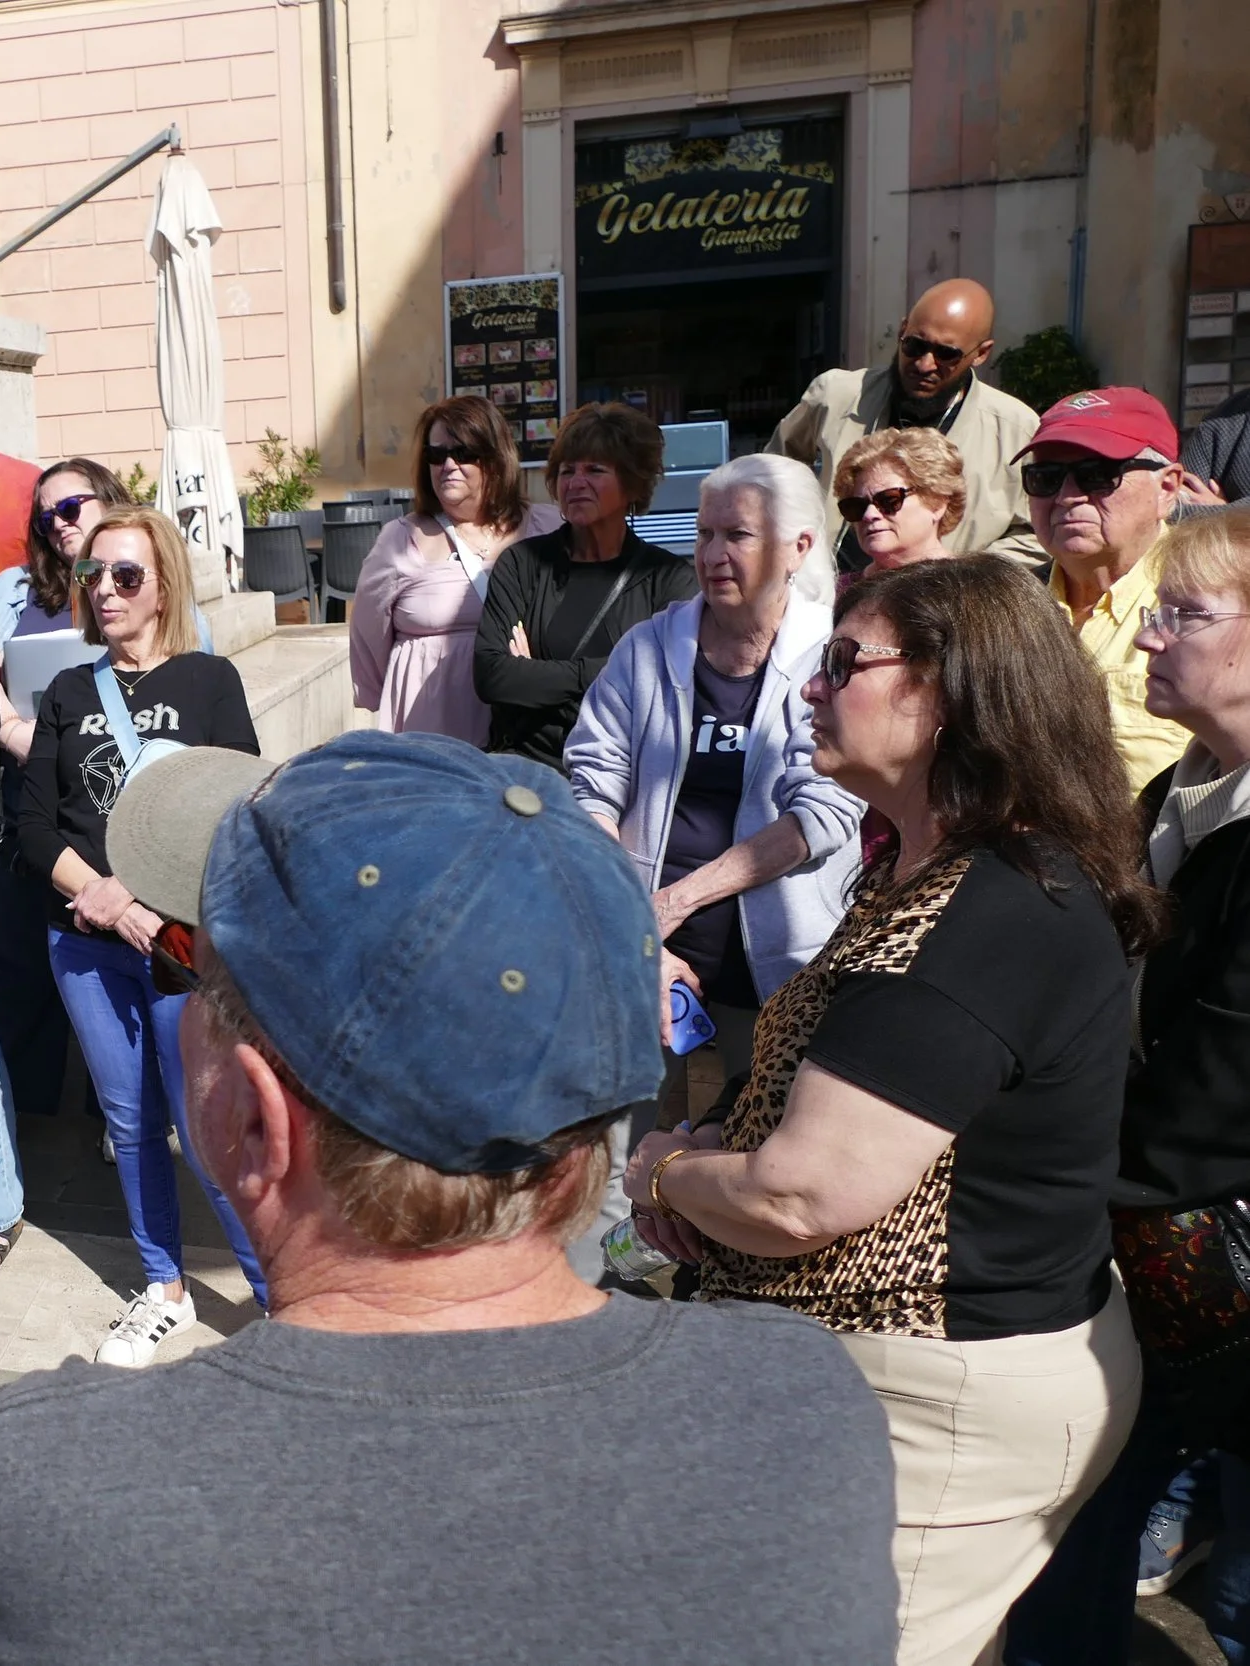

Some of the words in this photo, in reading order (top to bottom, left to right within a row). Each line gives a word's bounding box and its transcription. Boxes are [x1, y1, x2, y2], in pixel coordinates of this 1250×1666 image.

[596, 178, 810, 244] Gelateria
[700, 222, 801, 251] Gambella
[471, 309, 538, 330] Gelateria
[78, 702, 180, 736] Rsh
